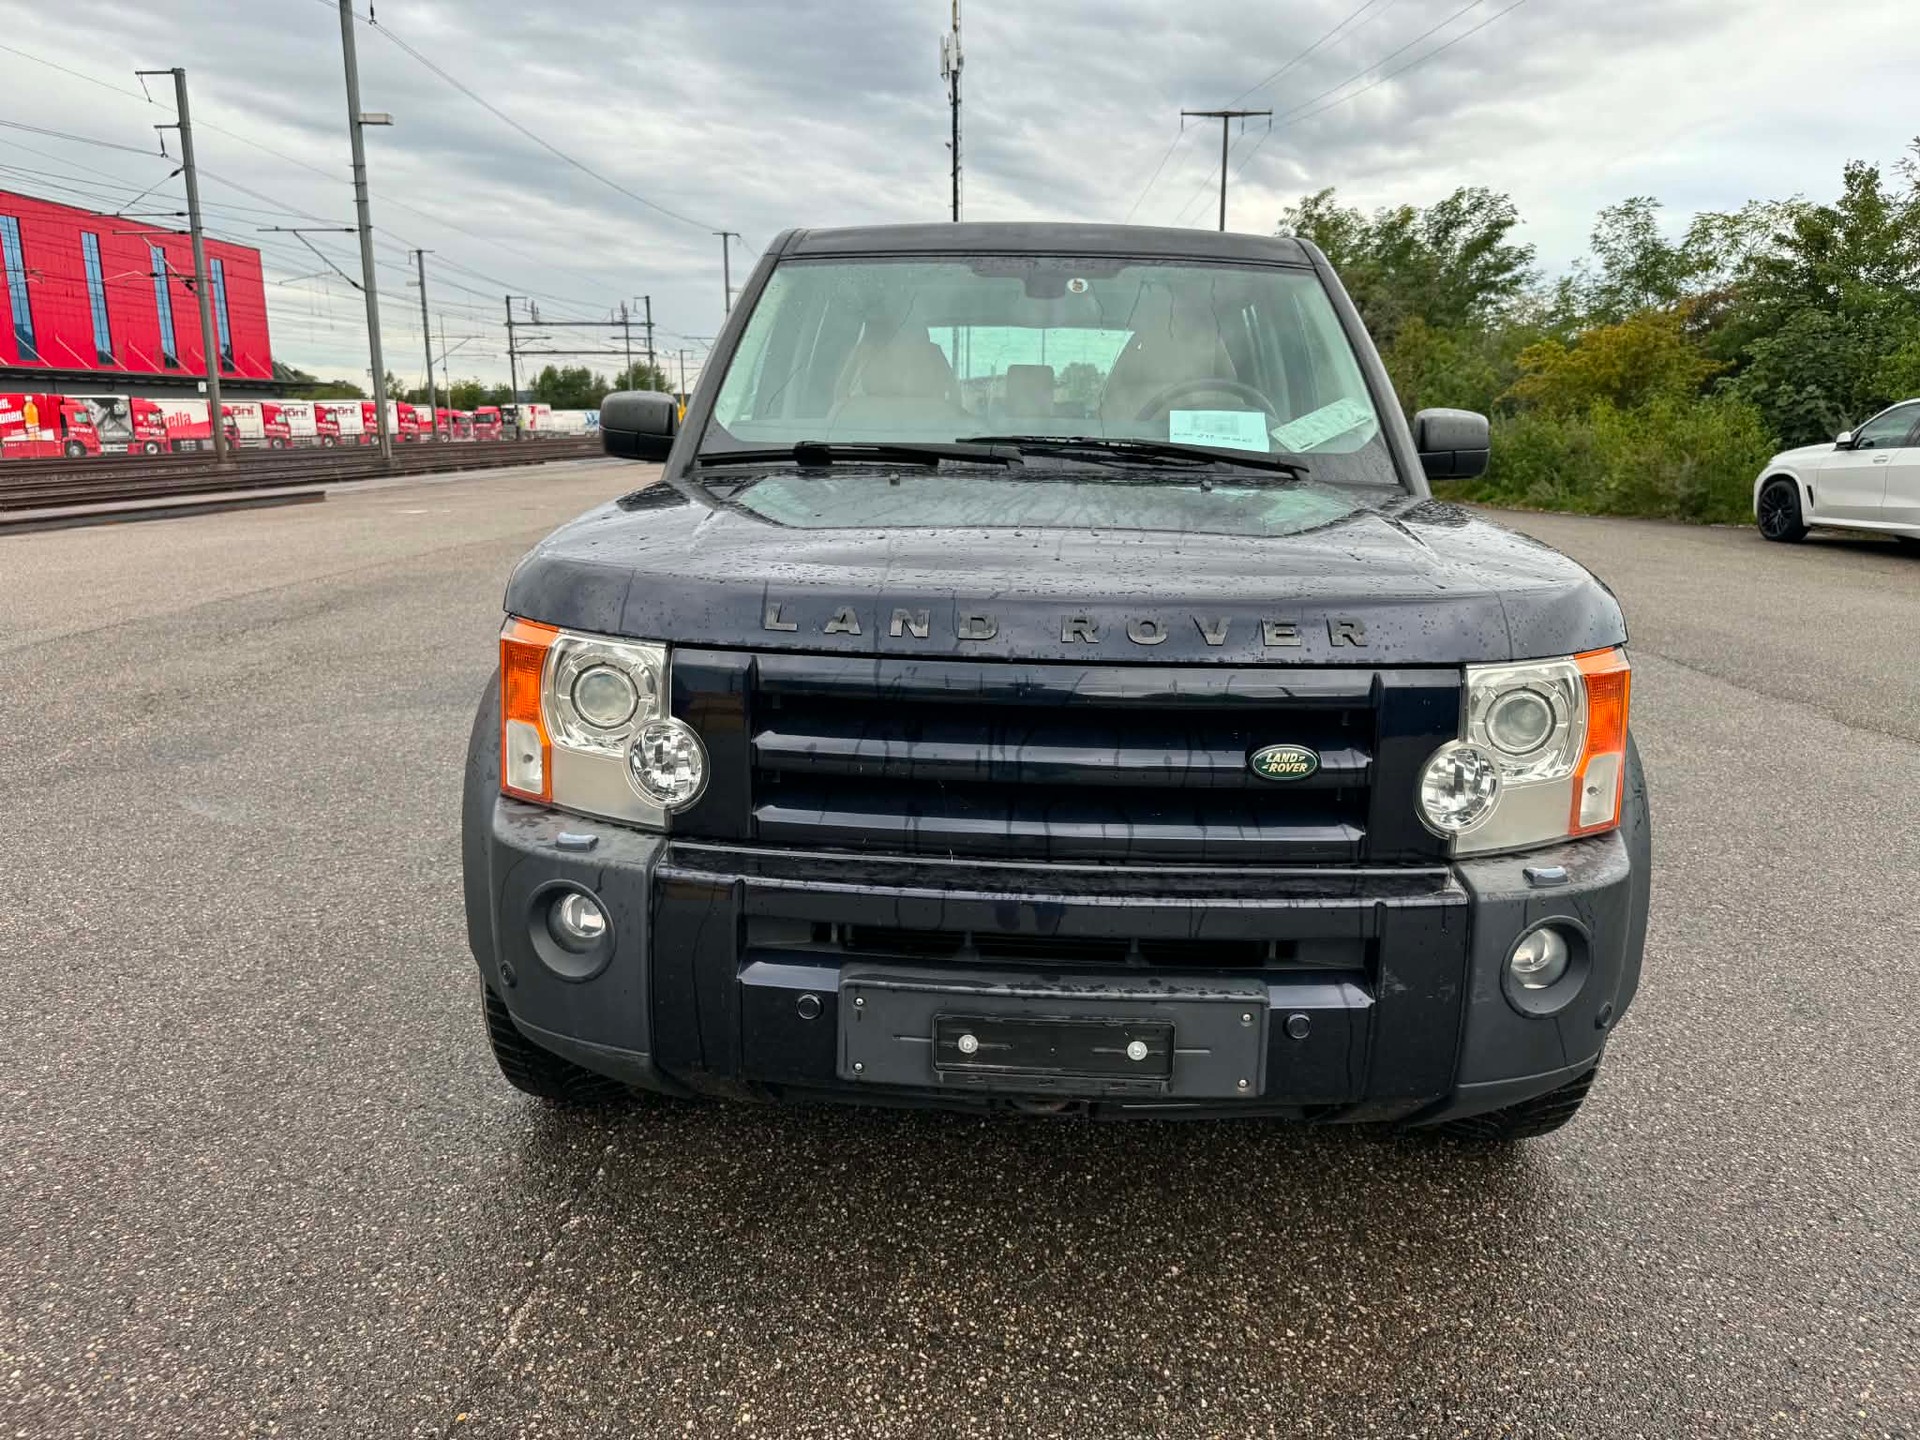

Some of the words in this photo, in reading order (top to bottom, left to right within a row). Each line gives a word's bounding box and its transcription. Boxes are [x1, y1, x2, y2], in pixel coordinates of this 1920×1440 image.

[764, 602, 998, 640] LAND
[1060, 613, 1368, 647] ROVER
[1266, 752, 1298, 763] LAND
[1268, 762, 1308, 773] ROVER
